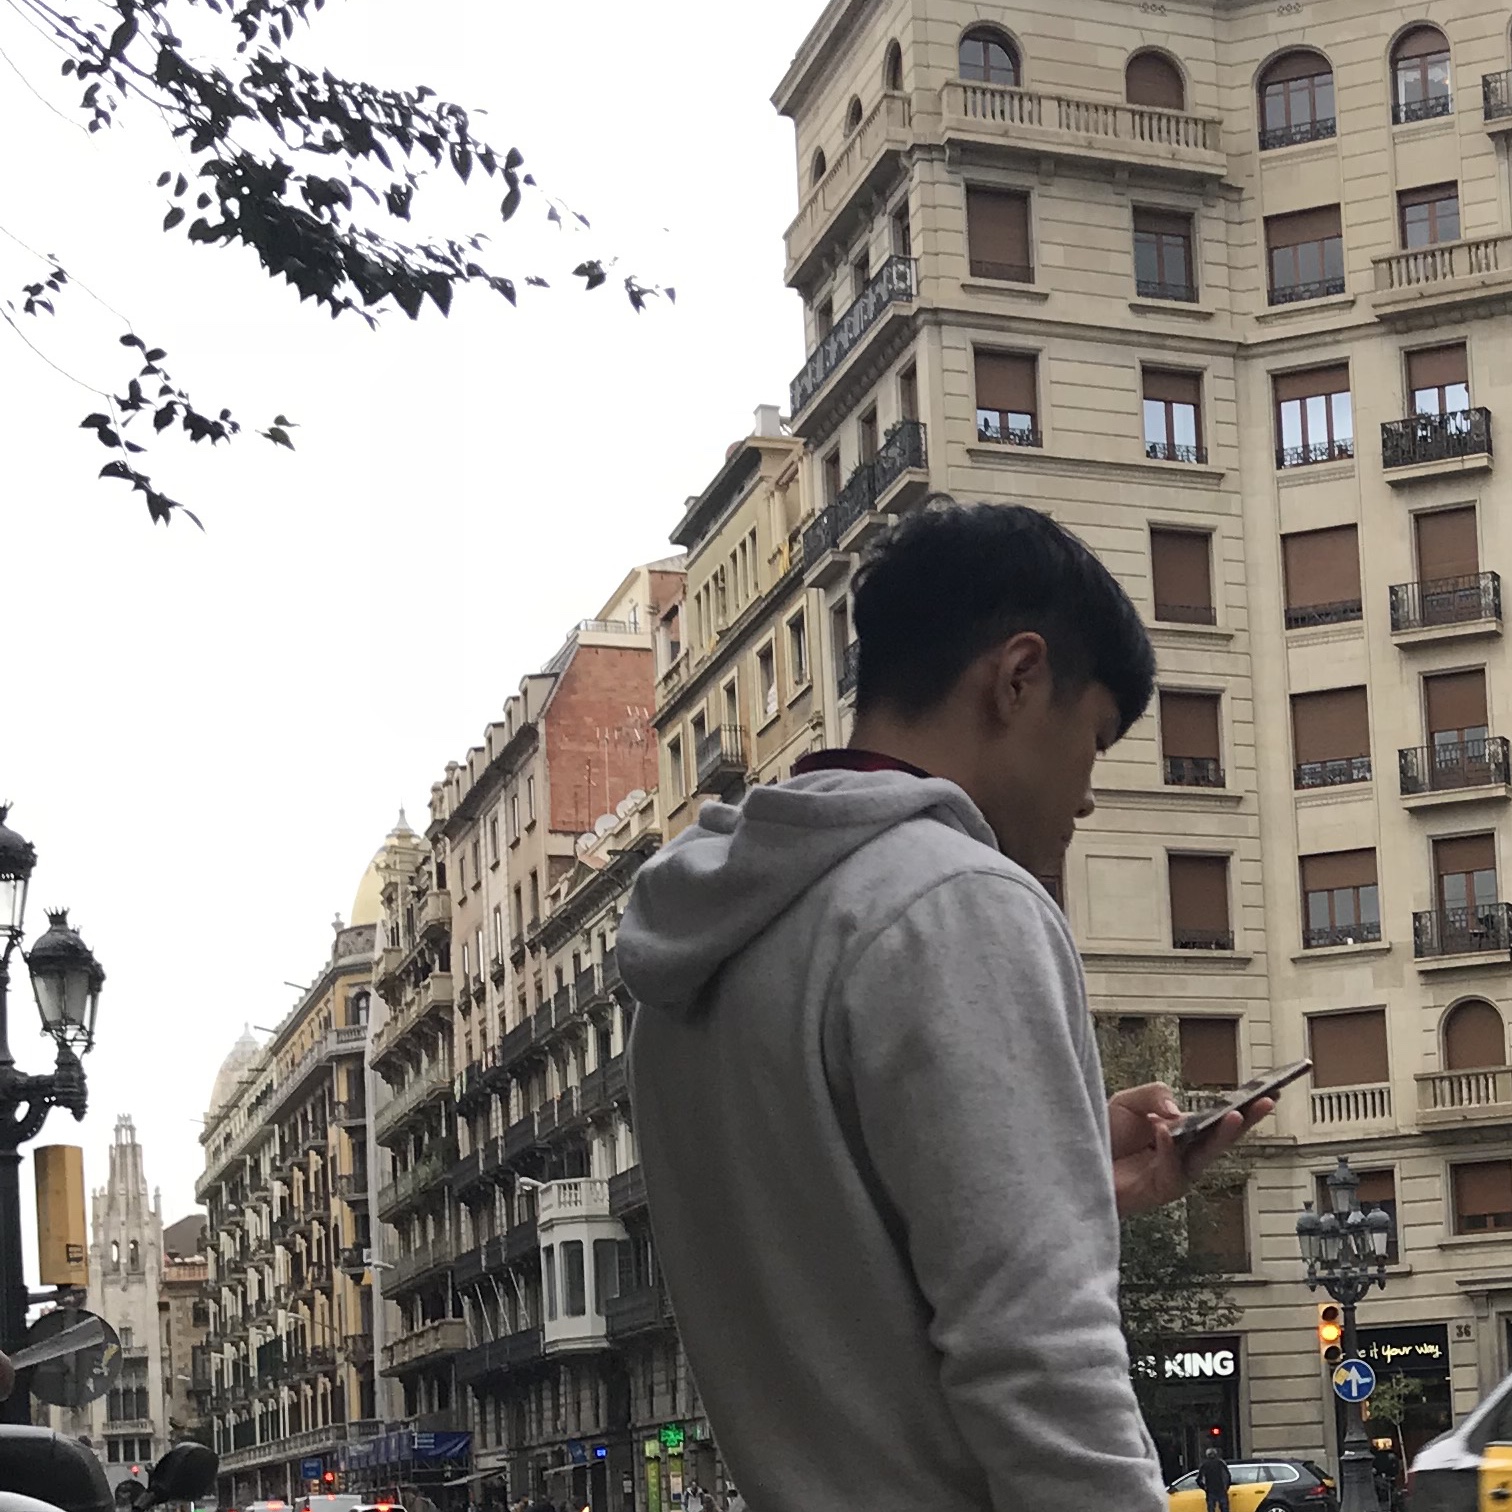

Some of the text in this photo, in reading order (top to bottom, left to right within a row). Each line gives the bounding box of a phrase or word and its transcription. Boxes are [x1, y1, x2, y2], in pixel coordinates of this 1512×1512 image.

[1456, 1324, 1472, 1338] 36
[1369, 1341, 1379, 1360] it
[1164, 1350, 1235, 1378] KING
